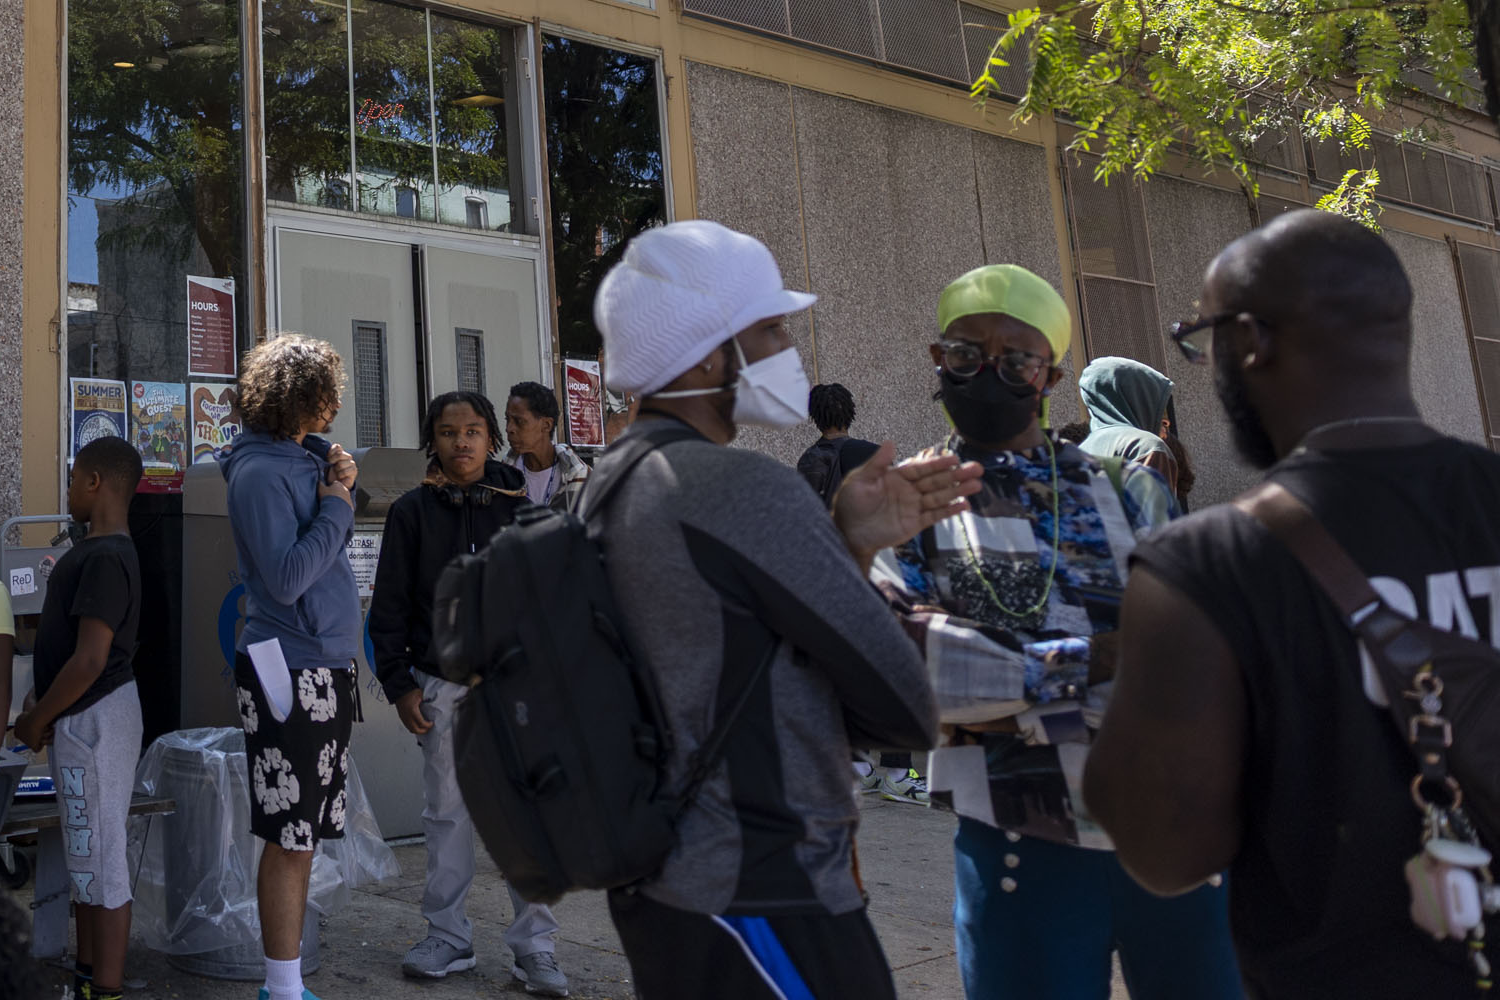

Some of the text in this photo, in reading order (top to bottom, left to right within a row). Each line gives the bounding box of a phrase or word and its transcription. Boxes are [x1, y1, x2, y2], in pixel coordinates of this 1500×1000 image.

[356, 98, 405, 128] Open
[191, 301, 219, 312] HOURS
[77, 384, 122, 398] SUMMER
[568, 382, 590, 391] HOURS
[138, 394, 180, 409] ULTIMATE
[146, 404, 174, 417] QUEST
[355, 539, 375, 548] TRASH
[60, 766, 94, 858] NEW
